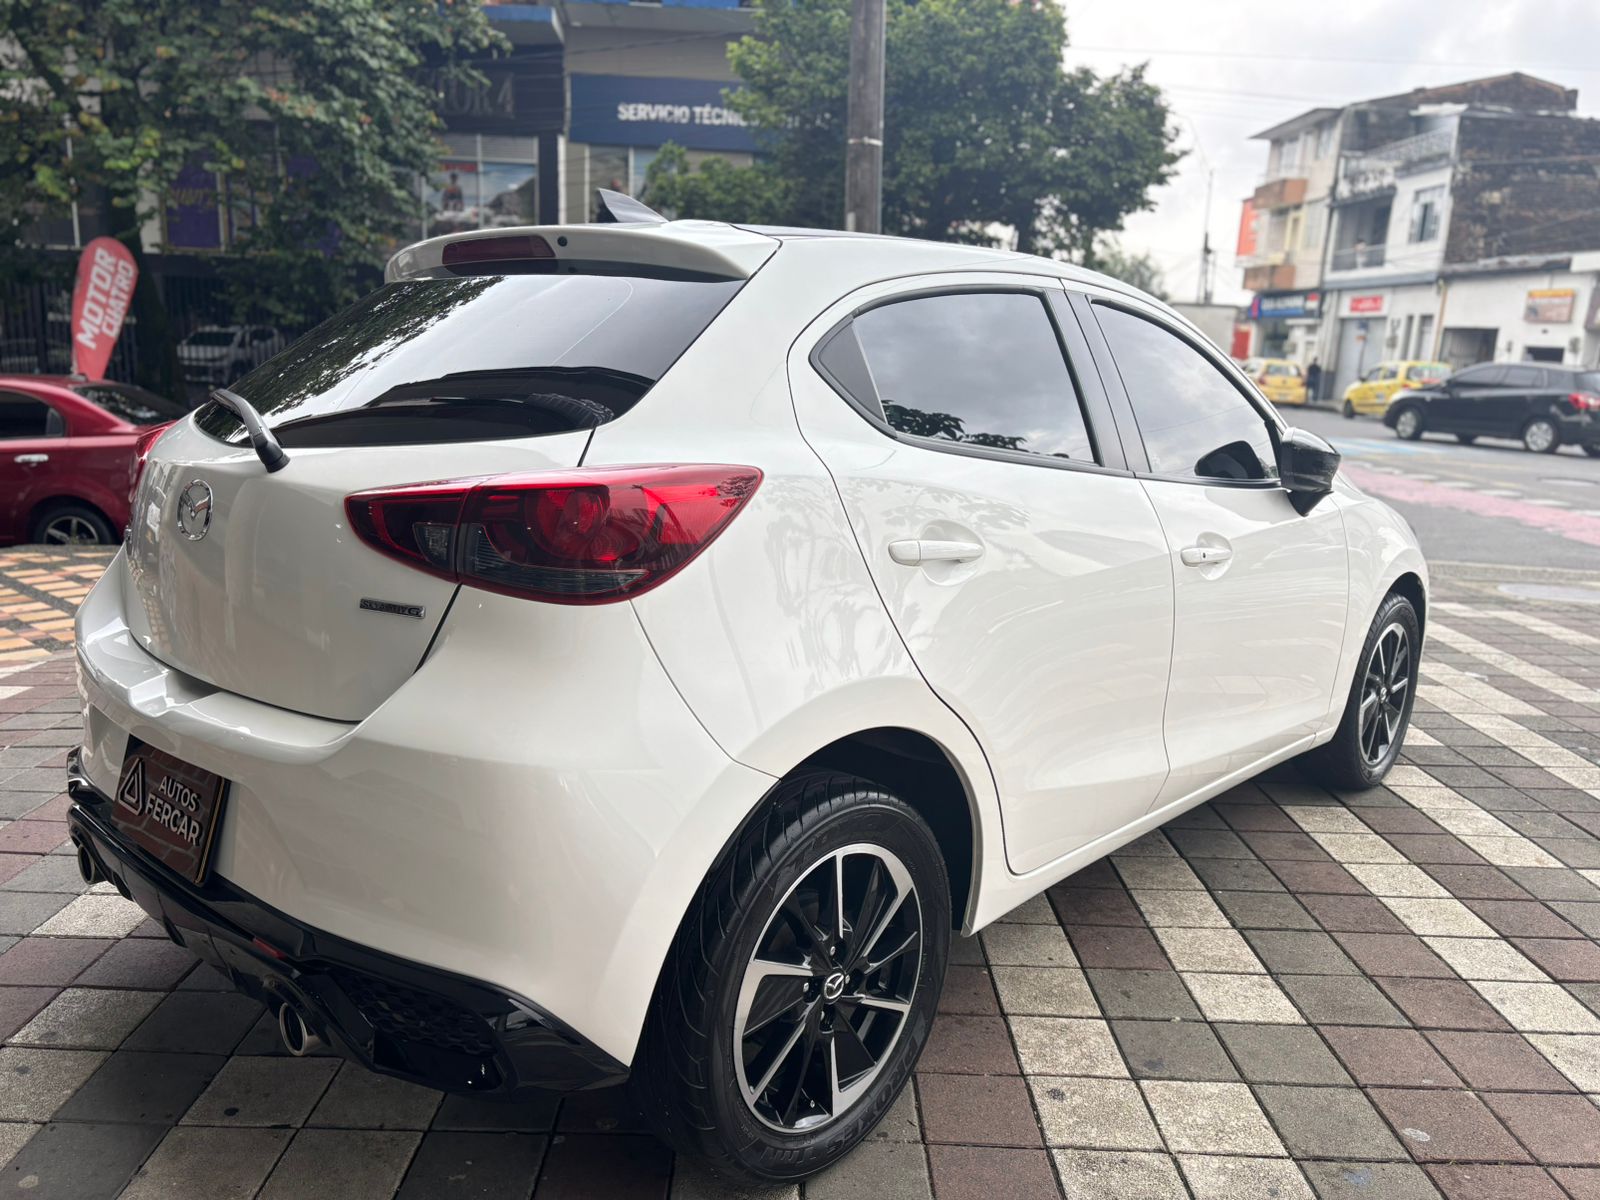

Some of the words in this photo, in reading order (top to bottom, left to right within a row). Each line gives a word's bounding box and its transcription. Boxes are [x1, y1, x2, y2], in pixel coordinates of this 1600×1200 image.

[617, 102, 690, 124] SERVICIO
[76, 247, 116, 351] MOTOR
[102, 259, 134, 337] CUATRO
[145, 793, 200, 846] FERCAR
[158, 775, 199, 812] AUTOS
